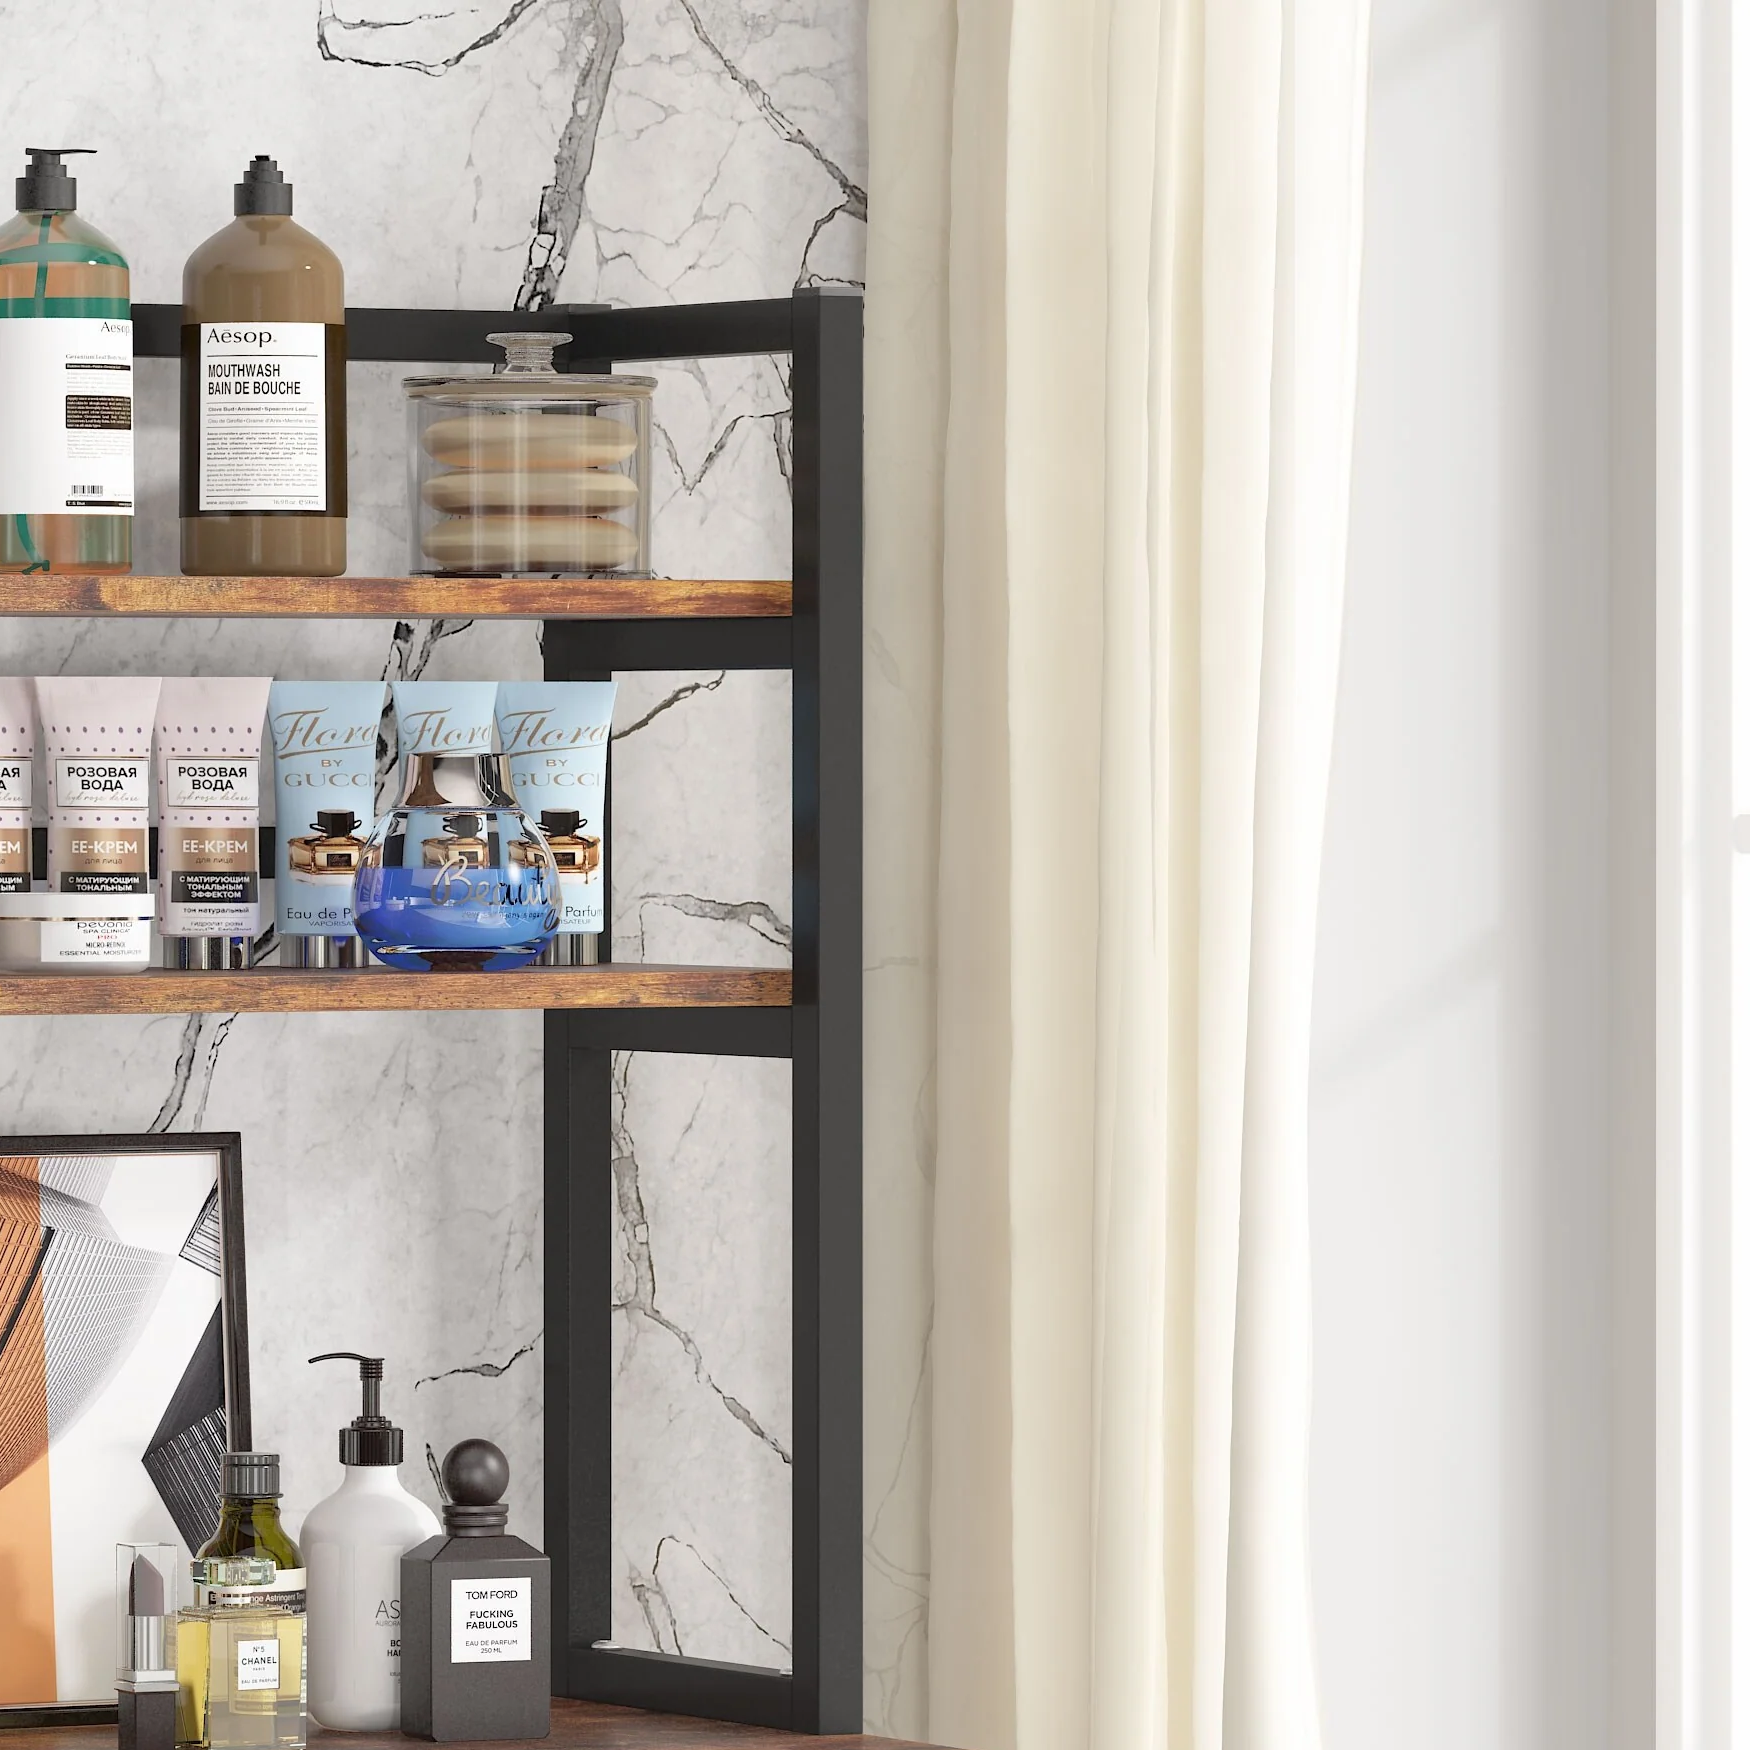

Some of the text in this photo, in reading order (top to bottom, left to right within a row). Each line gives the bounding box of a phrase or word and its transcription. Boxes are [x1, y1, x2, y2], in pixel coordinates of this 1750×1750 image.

[208, 364, 280, 377] MOUTHWASH
[208, 381, 301, 395] BAIN DE BOUCHE
[273, 707, 378, 752] Flora
[501, 707, 607, 751] Flora
[321, 759, 343, 767] BY
[67, 767, 137, 778] РОЗОВАЯ
[178, 767, 247, 778] РОЗОВАЯ
[192, 780, 234, 791] ВОДА
[285, 773, 372, 787] GUCCI
[512, 773, 599, 787] GUCCI
[81, 780, 123, 792] ВОДА
[76, 876, 139, 884] МАТИРУЮЩИМ
[187, 876, 249, 884] МАТИРУЮЩИМ
[431, 855, 563, 931] Beauty
[287, 908, 311, 919] Eau
[318, 908, 337, 919] de
[77, 922, 132, 930] pevonia
[266, 1593, 295, 1602] Astringent
[466, 1590, 518, 1600] TOM FORD
[470, 1610, 514, 1619] FUCKING
[466, 1620, 518, 1629] FABULOUS
[241, 1657, 277, 1665] CHANEL
